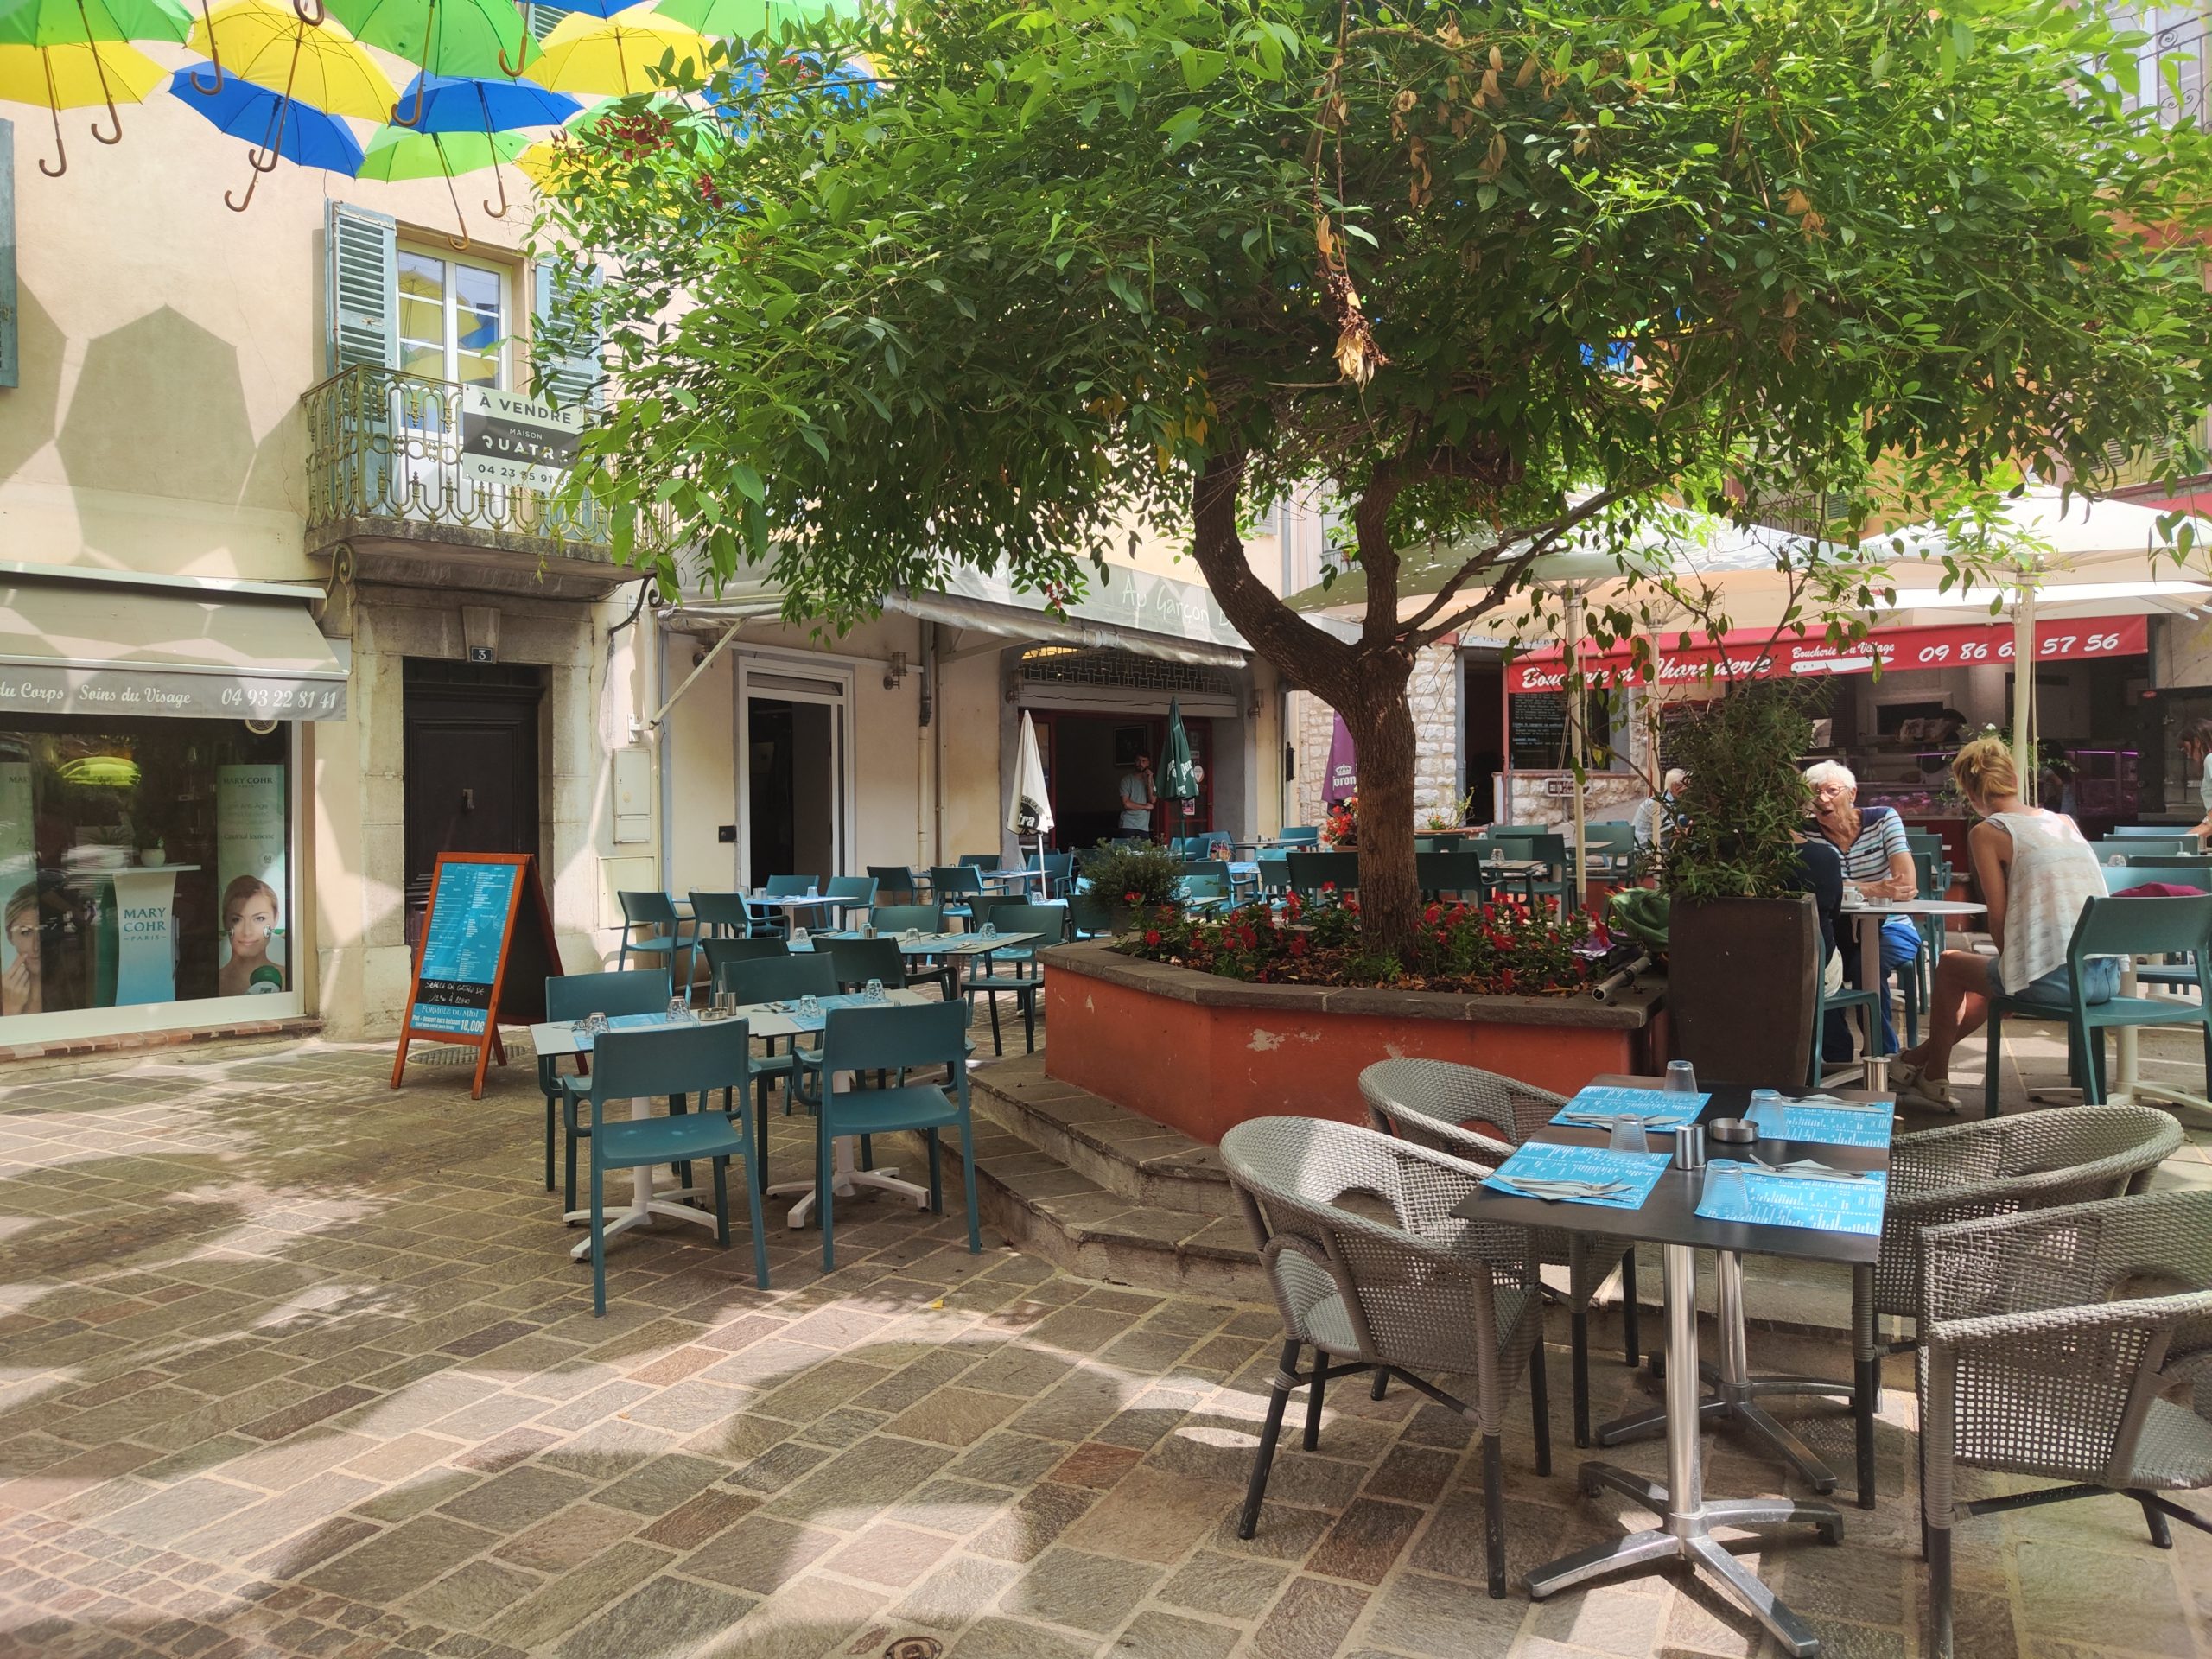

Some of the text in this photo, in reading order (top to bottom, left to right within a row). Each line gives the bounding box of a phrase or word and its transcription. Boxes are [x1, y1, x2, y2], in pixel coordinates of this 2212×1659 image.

[479, 391, 572, 425] À VENDRE
[509, 428, 543, 441] MAISON
[478, 463, 495, 475] 04
[500, 467, 516, 479] 23
[540, 474, 553, 485] 91
[1122, 573, 1147, 608] Au
[1156, 584, 1210, 624] Garçon
[478, 649, 486, 660] 3
[1791, 645, 1837, 659] Boucherie
[1918, 632, 2120, 663] 09 86 6 57 56
[20, 682, 64, 704] Corps
[79, 684, 192, 709] Soins du Visage
[221, 687, 337, 709] 04 93 22 81 41
[124, 907, 167, 919] MARY
[124, 920, 167, 933] COHR
